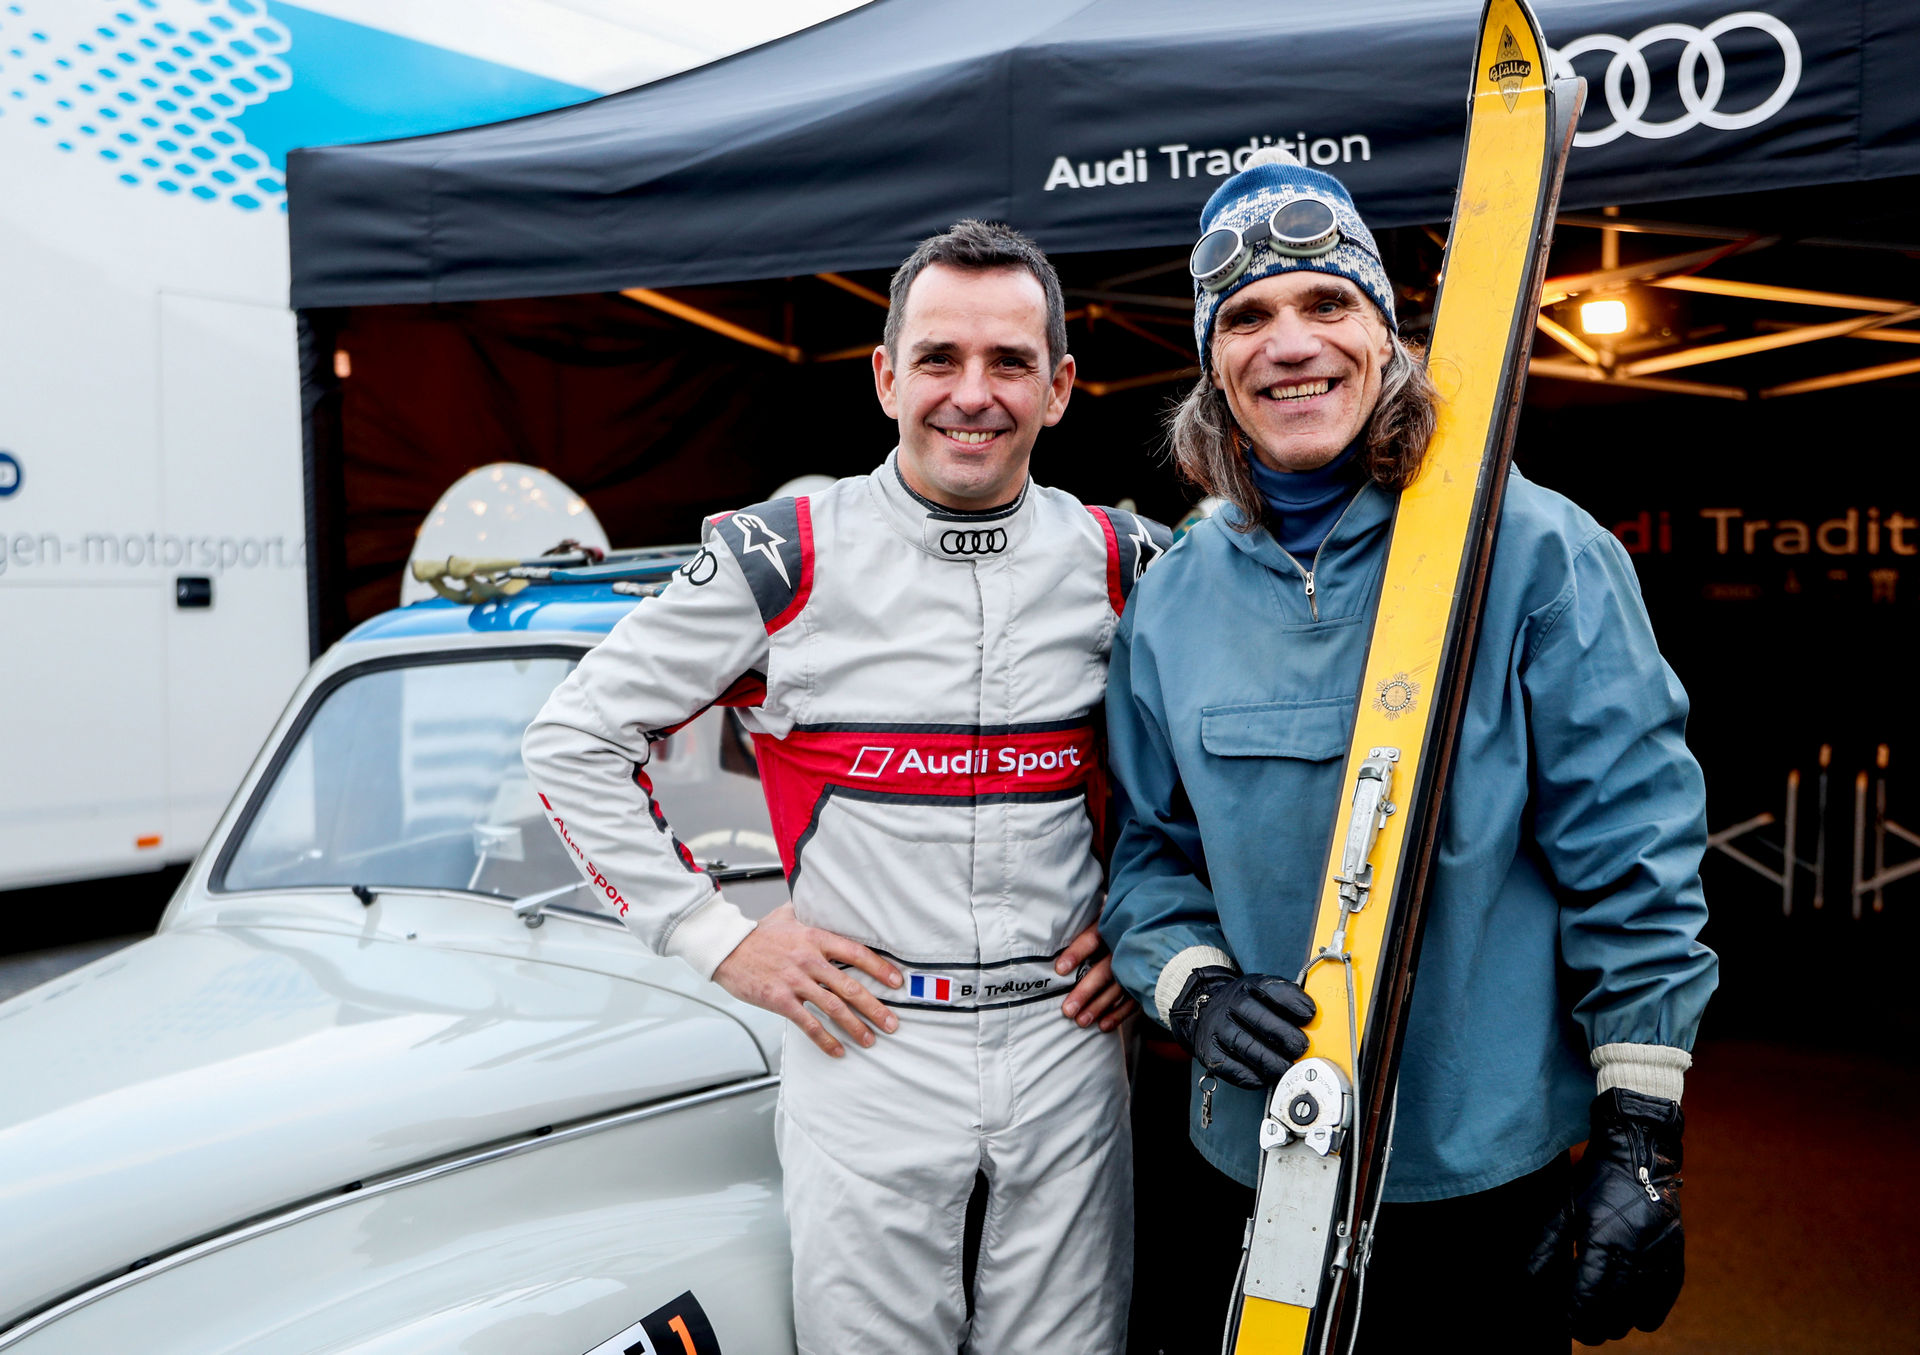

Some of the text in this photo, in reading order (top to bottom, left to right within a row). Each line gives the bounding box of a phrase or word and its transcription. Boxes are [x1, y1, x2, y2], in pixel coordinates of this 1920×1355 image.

[1044, 131, 1371, 190] Audi Tradion
[0, 531, 306, 577] en-motorsport.
[1700, 506, 1920, 556] Tradit
[998, 745, 1081, 777] Sport
[586, 861, 629, 917] Sport
[961, 984, 977, 997] B.
